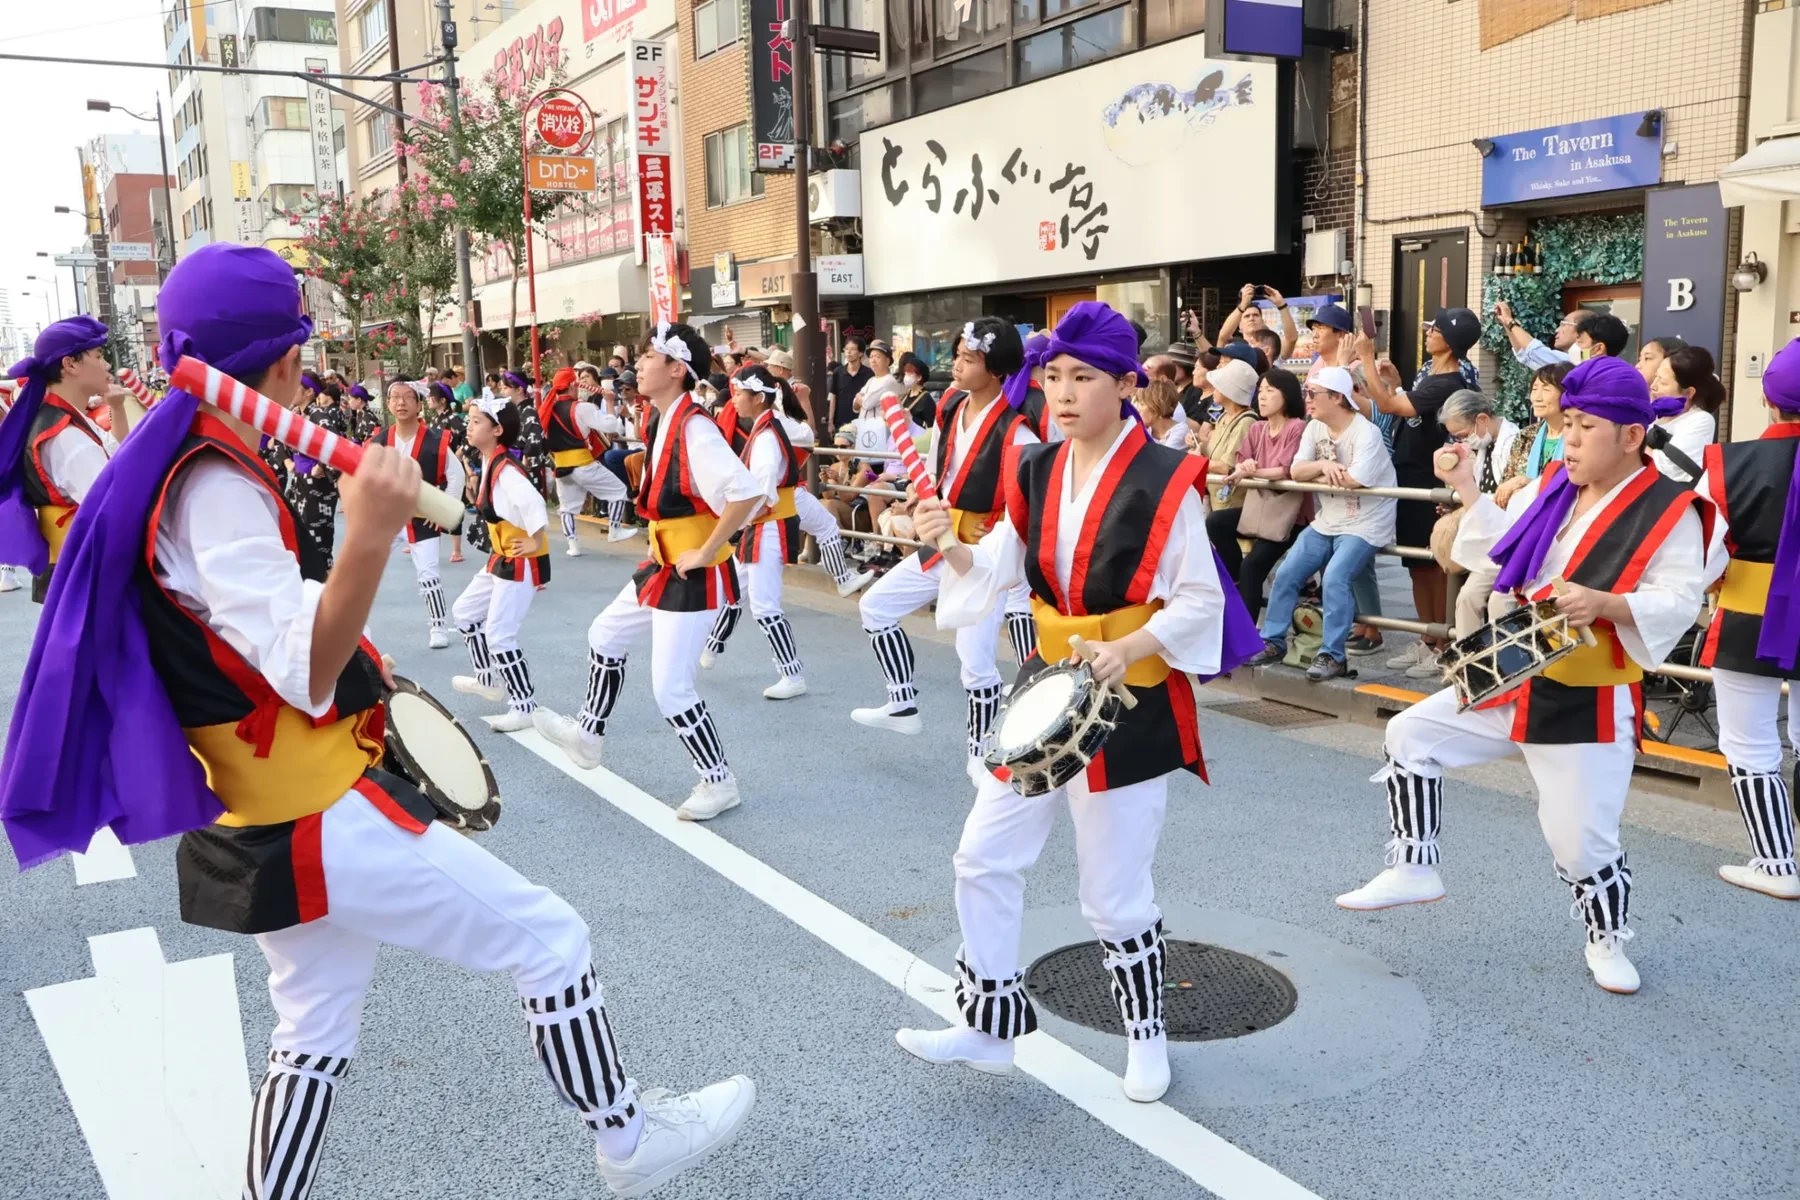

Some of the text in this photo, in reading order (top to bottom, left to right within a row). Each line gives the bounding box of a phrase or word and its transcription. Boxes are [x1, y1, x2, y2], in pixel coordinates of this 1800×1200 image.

[636, 46, 662, 61] 2F
[658, 65, 668, 128] ファッション市場
[635, 76, 660, 146] サンキ
[314, 88, 331, 170] 香港本格飲茶
[541, 112, 581, 135] 消火栓
[759, 145, 784, 160] 2F
[1512, 132, 1615, 162] The Tavern
[539, 160, 589, 180] bnb+
[1570, 153, 1633, 171] in Asakusa
[545, 181, 579, 189] HOSTEL
[881, 136, 1110, 261] とらふぐ亭
[1663, 216, 1709, 228] The Tavern
[1666, 228, 1708, 239] in Asakusa
[762, 275, 786, 294] EAST
[831, 273, 853, 283] EAST
